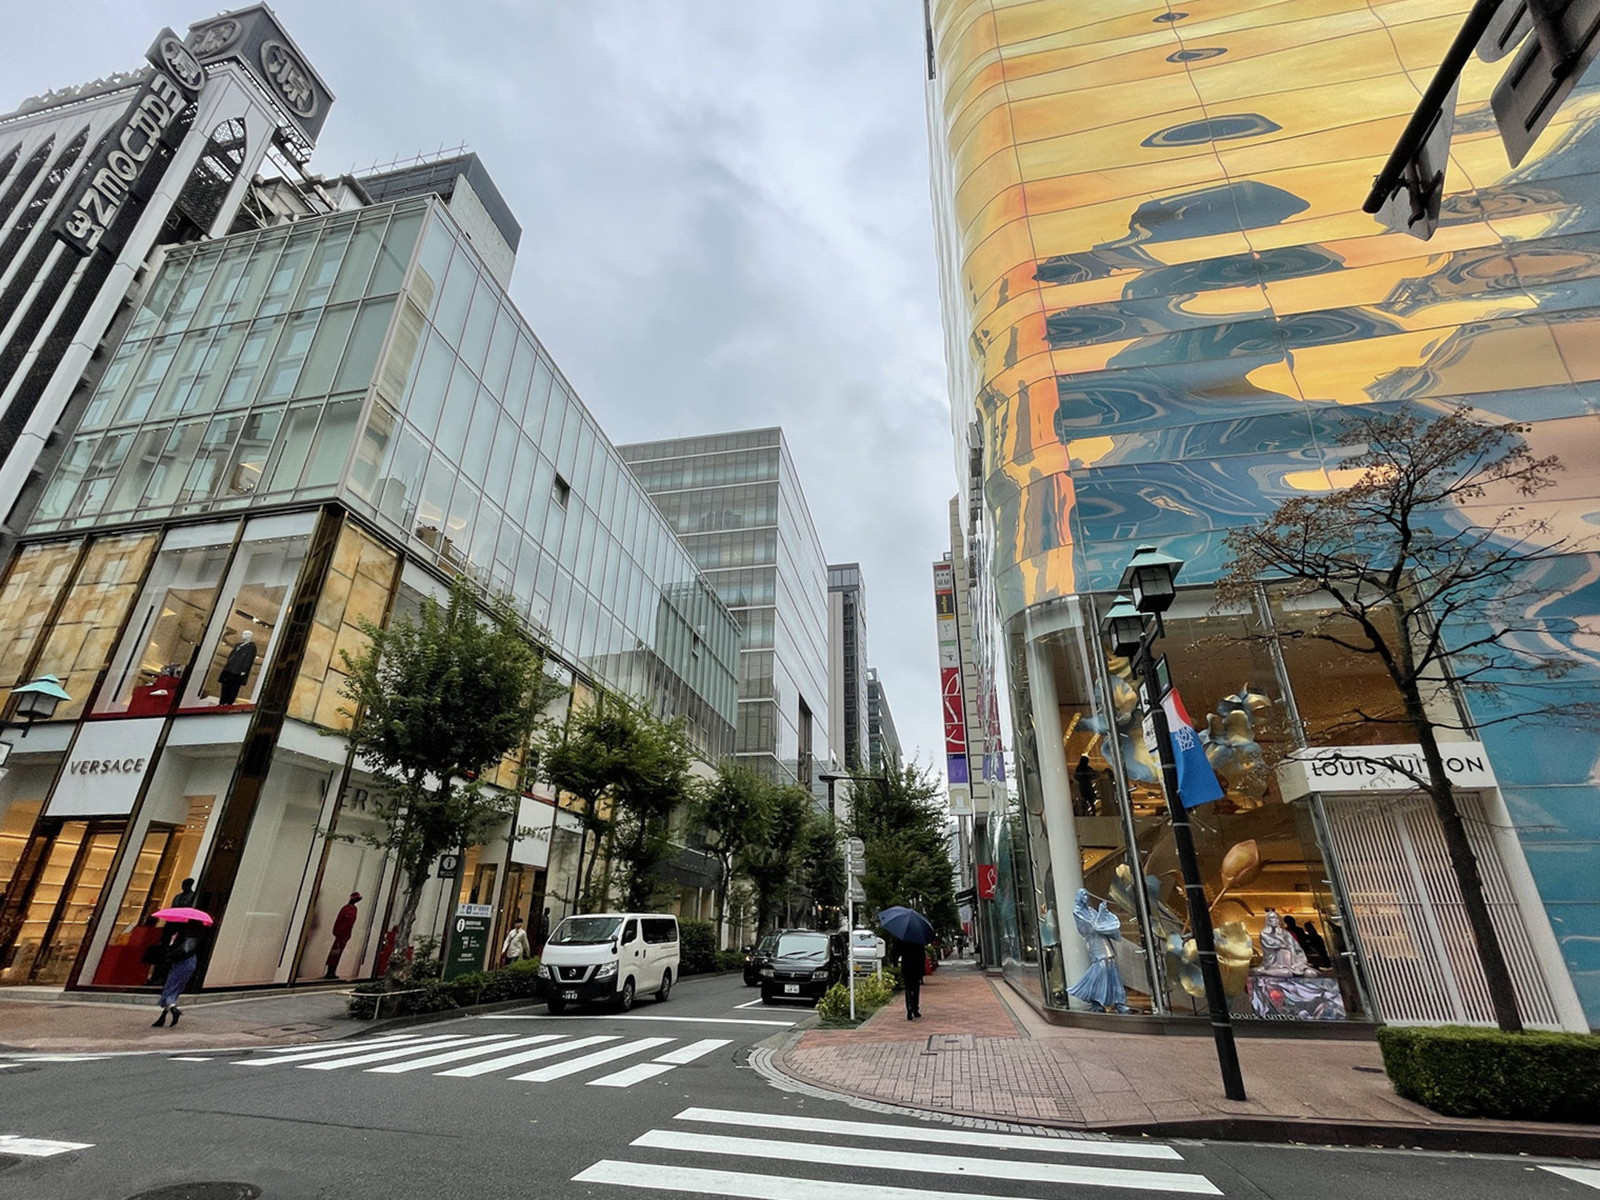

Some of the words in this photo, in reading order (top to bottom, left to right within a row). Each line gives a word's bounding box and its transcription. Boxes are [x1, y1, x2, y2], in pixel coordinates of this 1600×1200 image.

[86, 74, 187, 227] MARUGEN
[65, 210, 105, 250] 31
[69, 758, 145, 776] VERSACE
[1313, 762, 1376, 777] LOUIS
